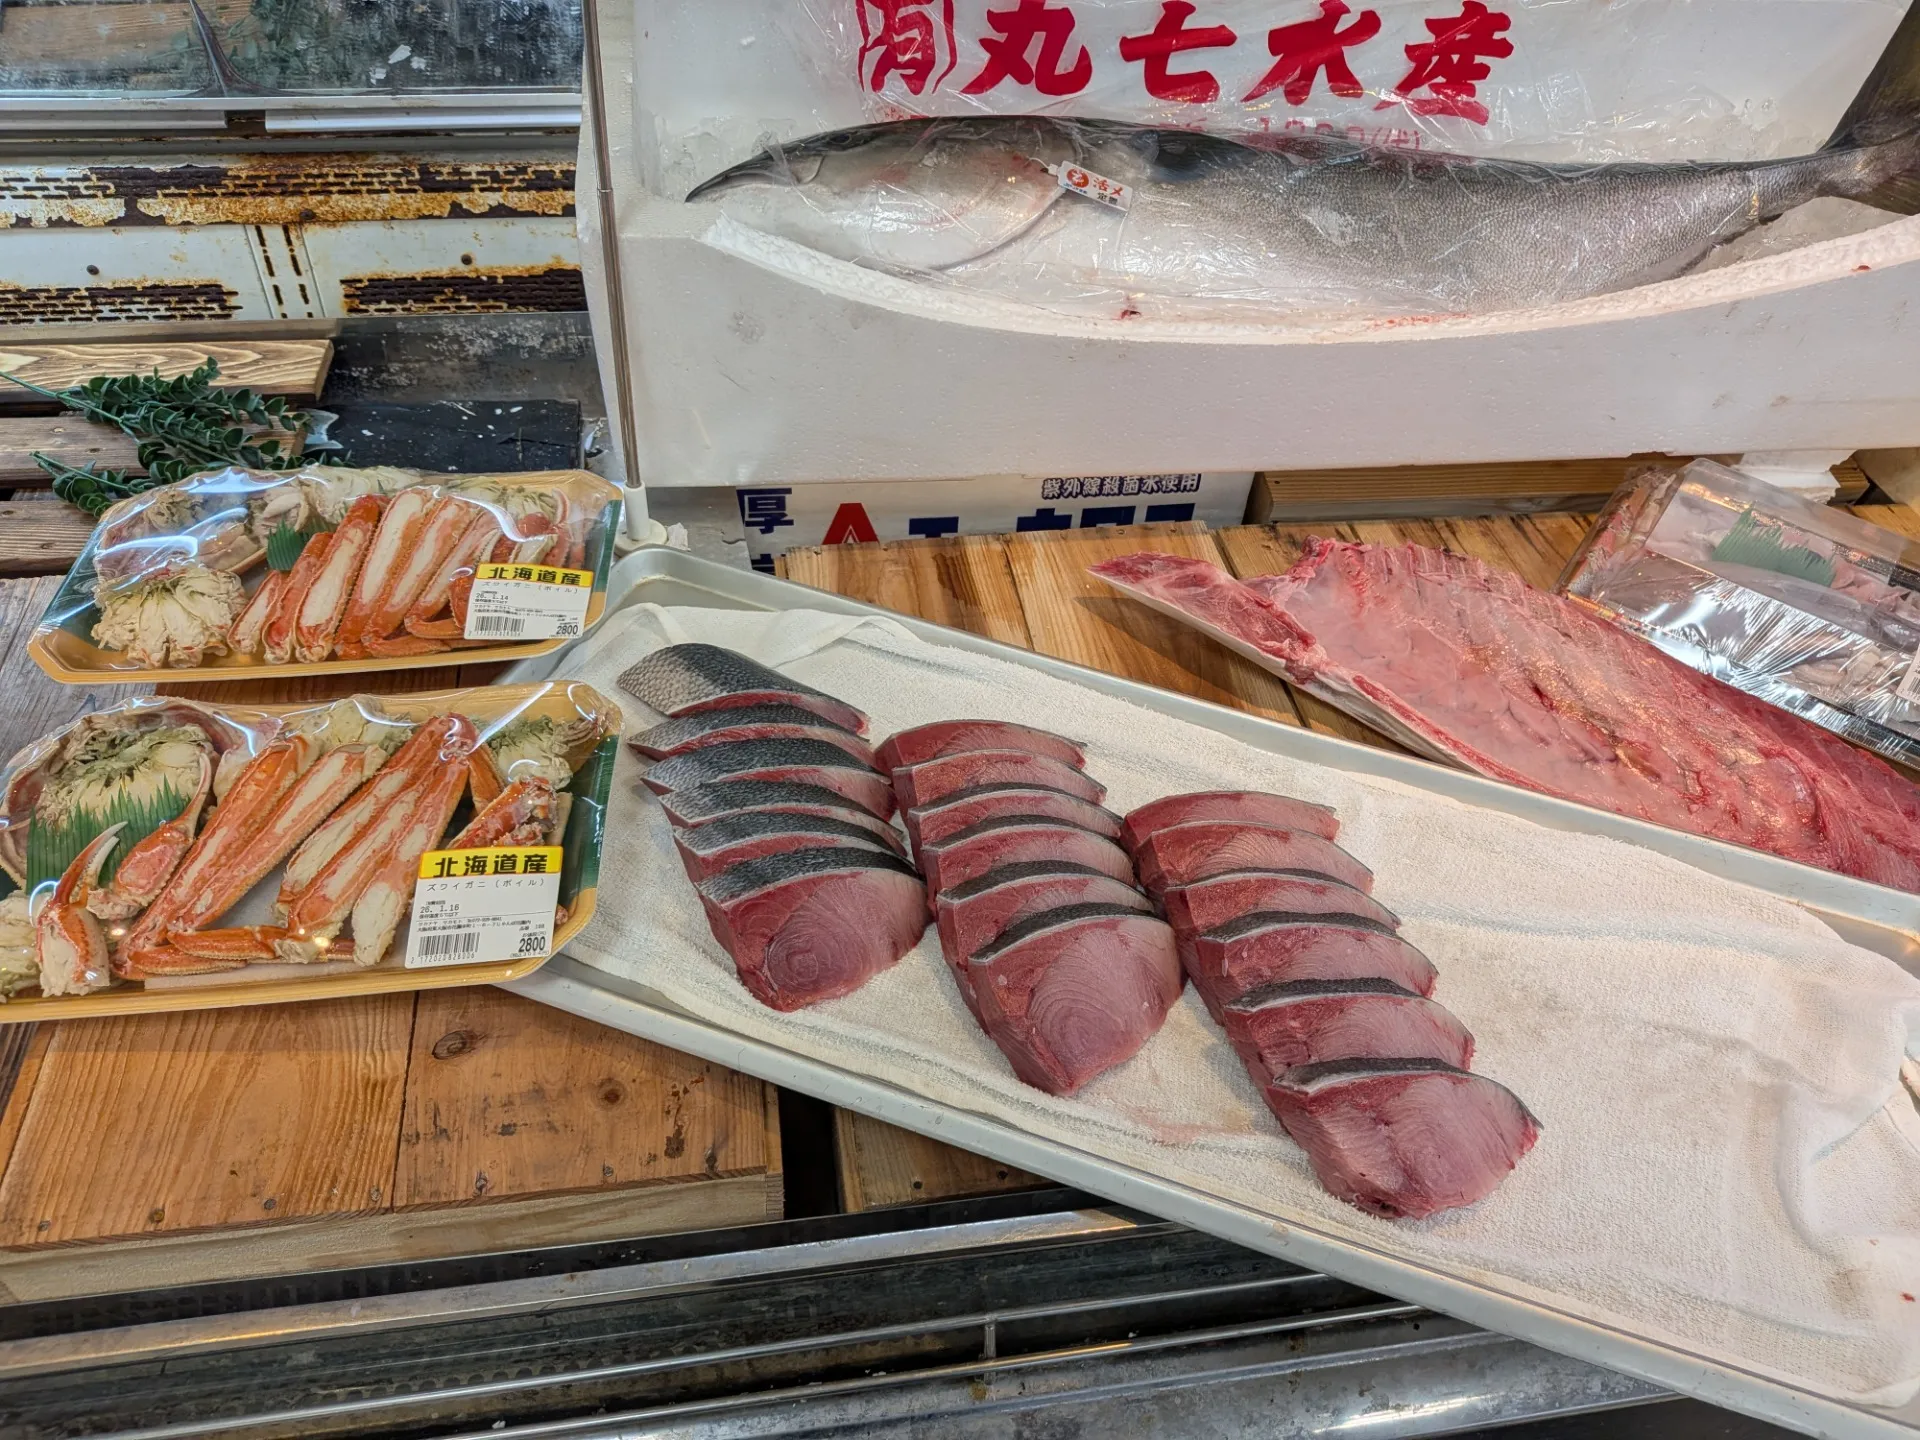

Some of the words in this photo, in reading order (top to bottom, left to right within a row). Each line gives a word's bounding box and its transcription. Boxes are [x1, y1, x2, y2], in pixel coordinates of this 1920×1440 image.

[1042, 473, 1201, 500] 紫外線殺菌水使用
[488, 567, 581, 586] 北海道産
[556, 624, 579, 635] 2800
[433, 854, 547, 878] 北海道産
[518, 936, 546, 952] 2800
